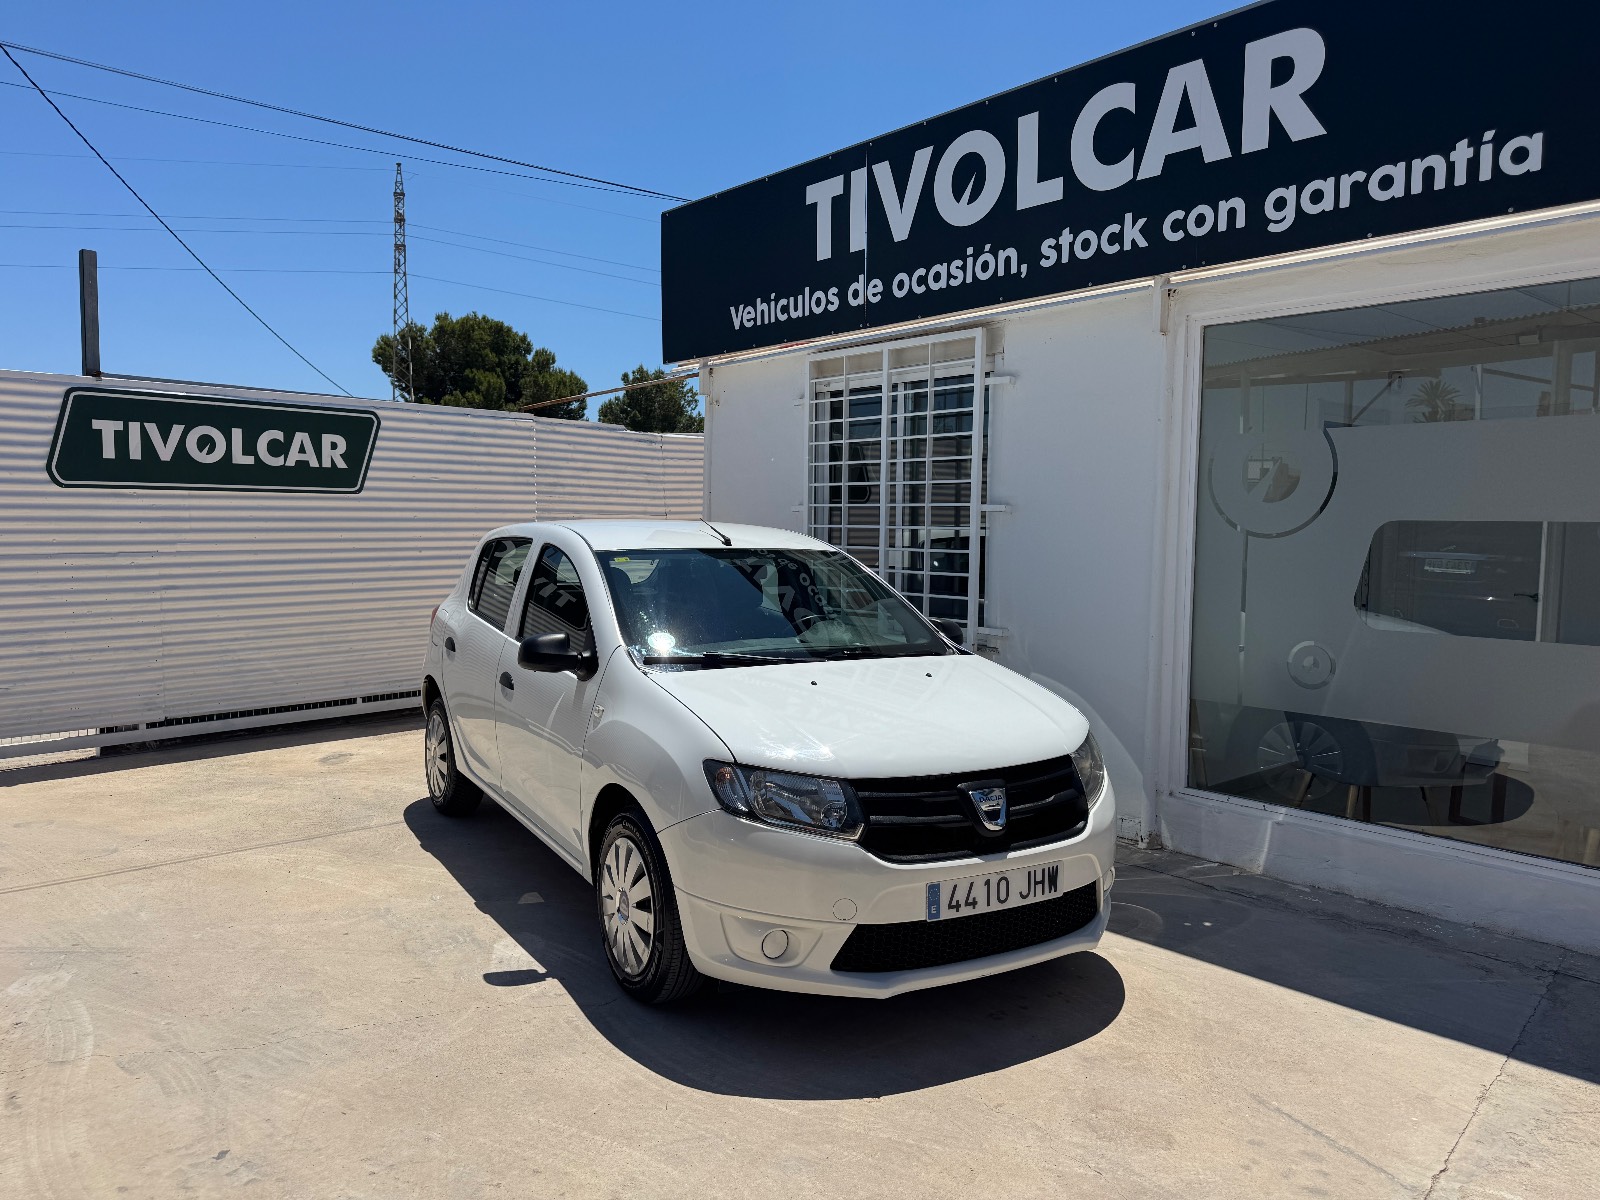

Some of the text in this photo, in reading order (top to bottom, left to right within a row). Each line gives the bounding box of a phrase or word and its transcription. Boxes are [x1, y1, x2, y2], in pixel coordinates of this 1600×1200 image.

[805, 27, 1328, 262] TIVOLCAR
[729, 130, 1544, 330] Vehículos de ocasión, stock con garantía
[91, 418, 349, 469] TIVOLCAR
[979, 794, 1003, 803] DACIA
[931, 865, 1059, 914] E 4410 JHW
